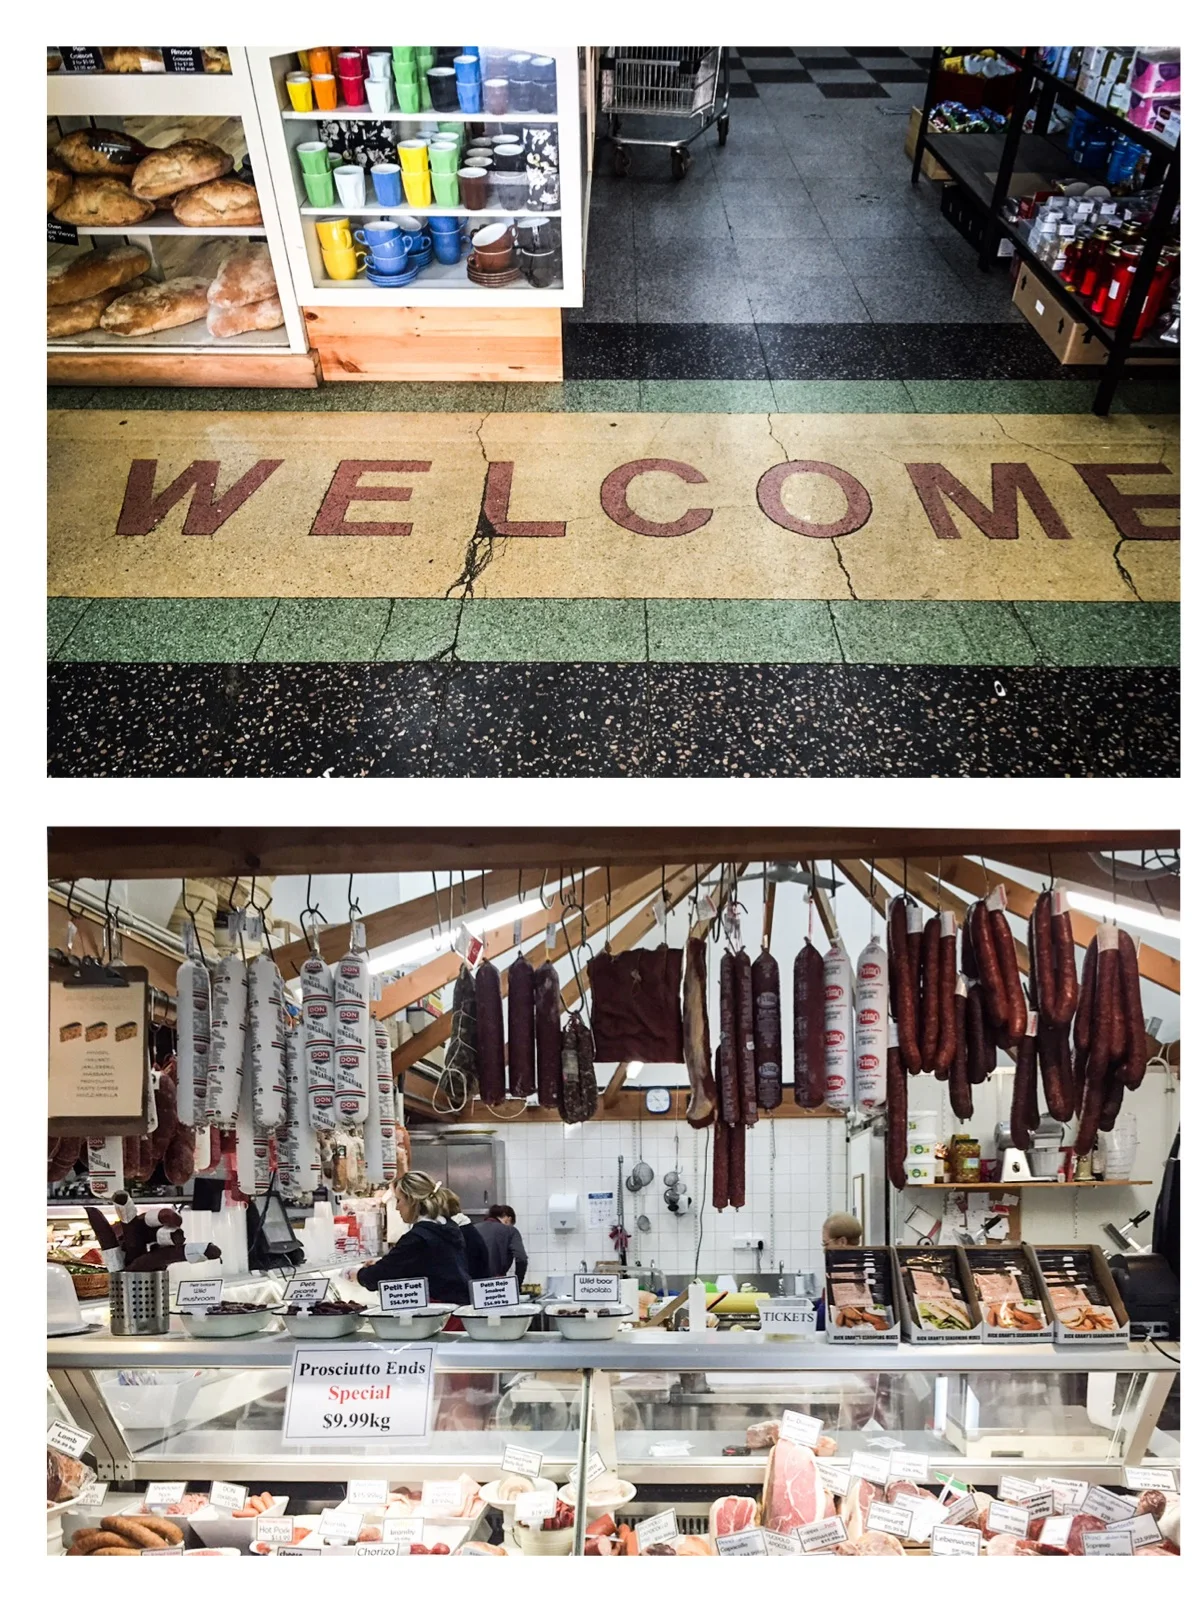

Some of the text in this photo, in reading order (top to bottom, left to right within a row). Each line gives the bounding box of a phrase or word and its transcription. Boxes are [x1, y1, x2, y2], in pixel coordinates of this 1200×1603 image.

[114, 457, 1182, 541] WELCOME
[341, 1101, 357, 1109] DON
[404, 1282, 422, 1290] Fuet
[581, 1286, 612, 1294] chipolata
[762, 1311, 814, 1322] TICKETS
[299, 1361, 426, 1376] Prosciutto Ends
[328, 1385, 391, 1404] Special
[322, 1412, 391, 1432] $9.99kg
[57, 1432, 78, 1444] Lamb
[259, 1525, 272, 1534] Hot
[356, 1547, 396, 1556] Chorizo
